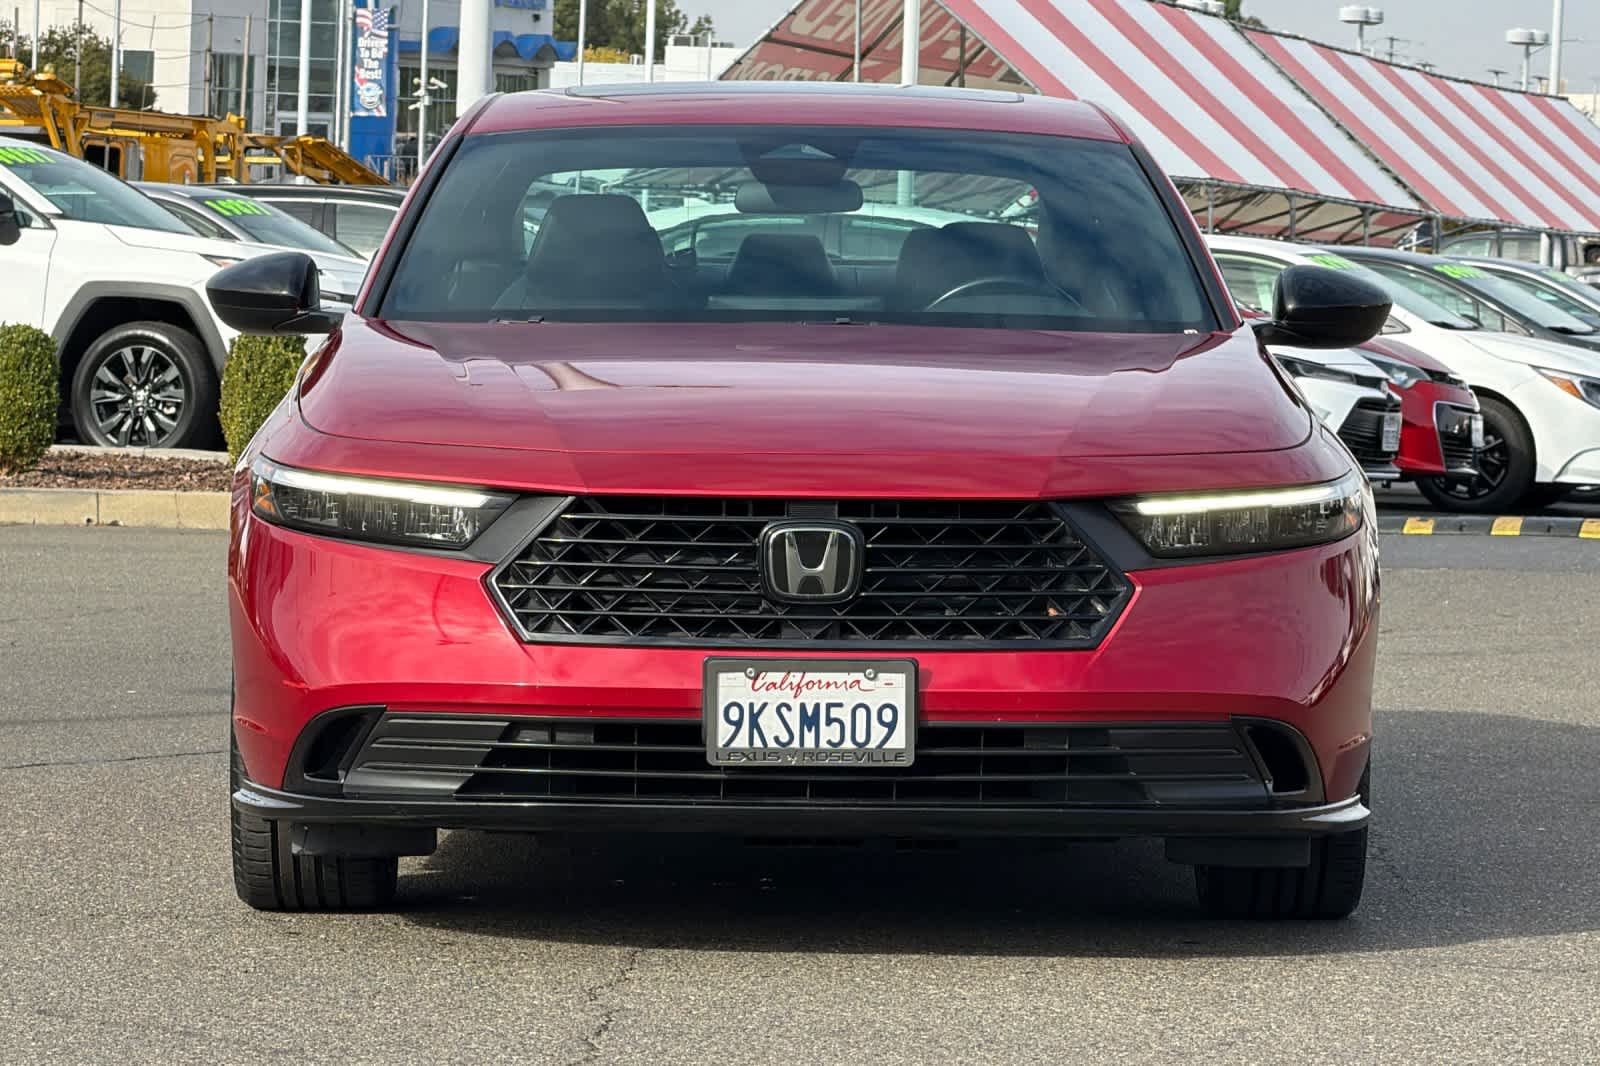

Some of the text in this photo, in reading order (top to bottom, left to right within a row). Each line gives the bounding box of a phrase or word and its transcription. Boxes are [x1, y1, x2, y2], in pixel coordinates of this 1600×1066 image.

[752, 672, 876, 699] California
[722, 701, 899, 749] 9KSM509
[715, 751, 781, 762] LEXUS
[802, 751, 907, 762] ROSEVILLE
